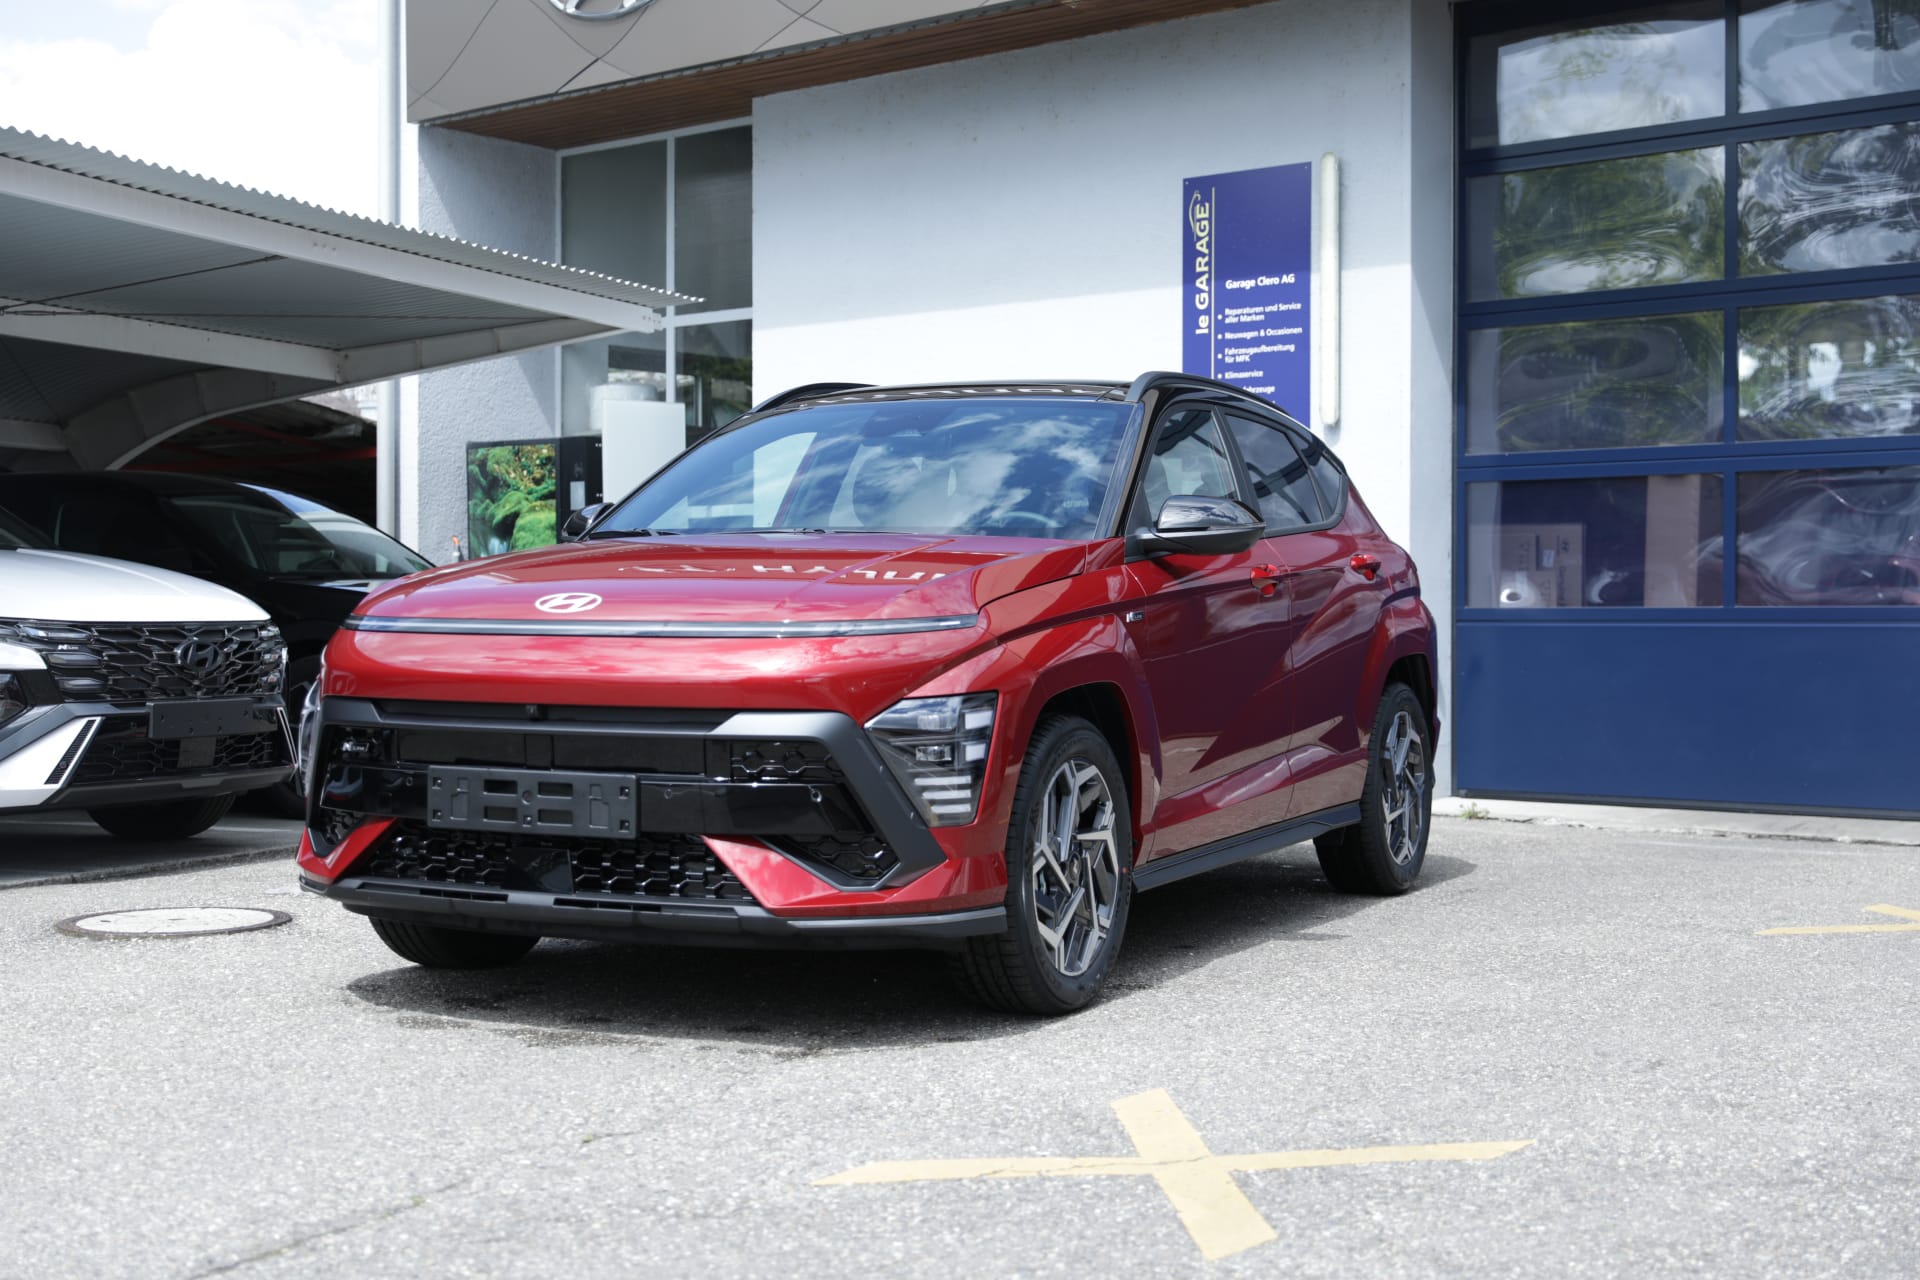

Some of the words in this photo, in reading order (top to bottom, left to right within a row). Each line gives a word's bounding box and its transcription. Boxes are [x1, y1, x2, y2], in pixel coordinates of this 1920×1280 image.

[1195, 202, 1209, 310] GARAGE
[1225, 278, 1256, 290] Garage
[1257, 276, 1280, 286] Clero
[1281, 273, 1296, 284] AG
[1264, 303, 1278, 313] und
[1278, 302, 1302, 312] Service
[1239, 313, 1265, 322] Marken
[1195, 315, 1209, 335] le
[1259, 328, 1266, 337] &
[1265, 326, 1303, 337] Occasionen
